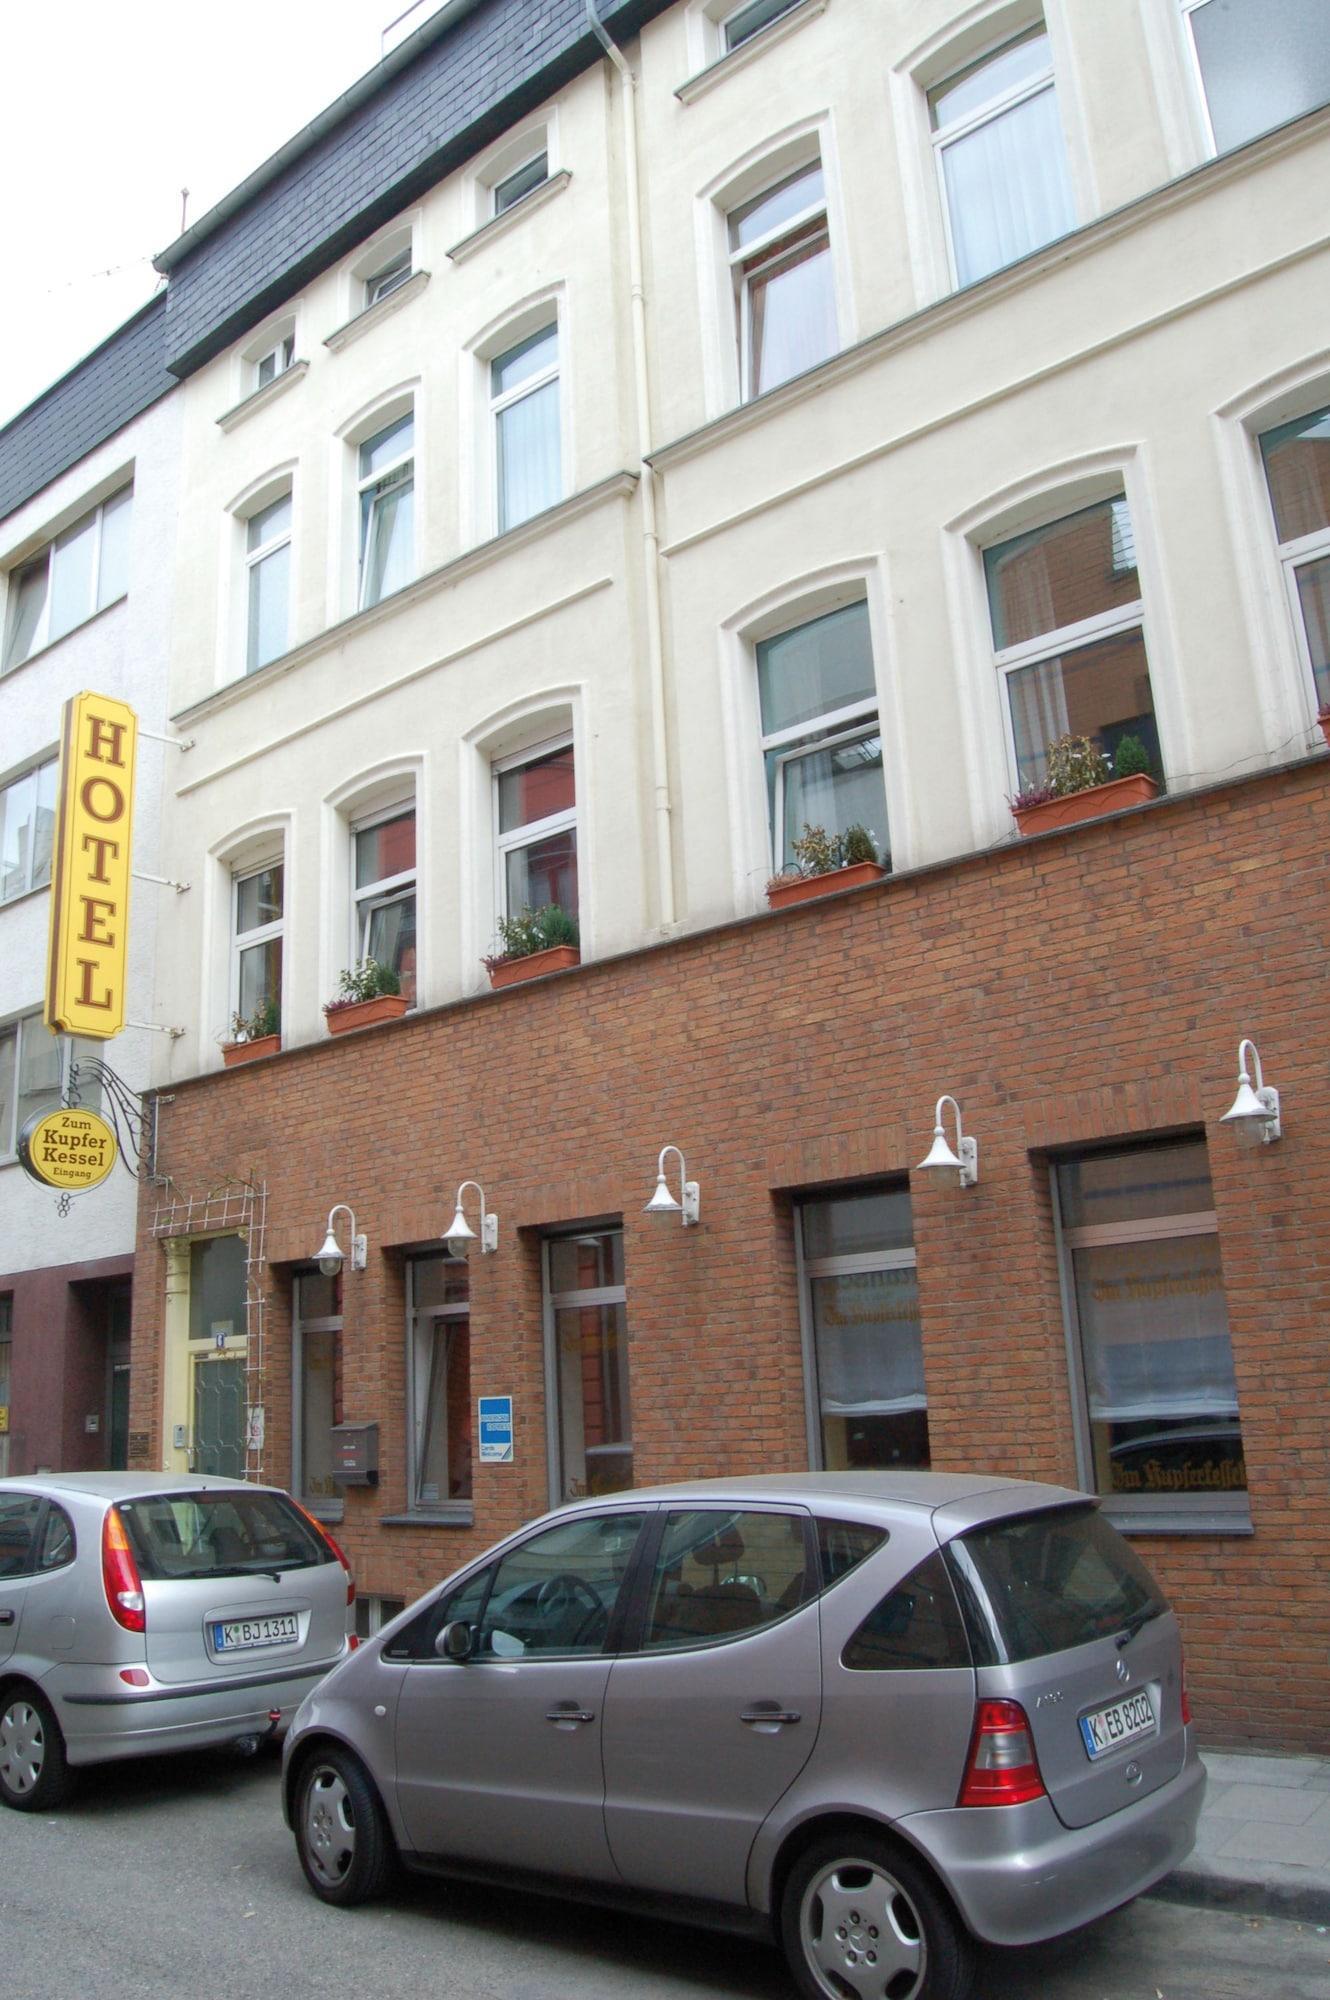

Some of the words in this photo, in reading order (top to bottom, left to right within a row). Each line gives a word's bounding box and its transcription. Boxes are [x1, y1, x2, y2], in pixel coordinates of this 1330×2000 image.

[74, 713, 127, 1011] HOTEL
[62, 1117, 92, 1130] Zum
[43, 1129, 107, 1150] Kupfer
[42, 1147, 104, 1166] Kessel
[53, 1167, 92, 1179] Eingang
[224, 1627, 234, 1643] K
[242, 1623, 260, 1640] BJ
[264, 1618, 296, 1638] 1311
[1089, 1718, 1103, 1746] K
[1105, 1708, 1124, 1739] EB
[1122, 1696, 1152, 1730] 8202
